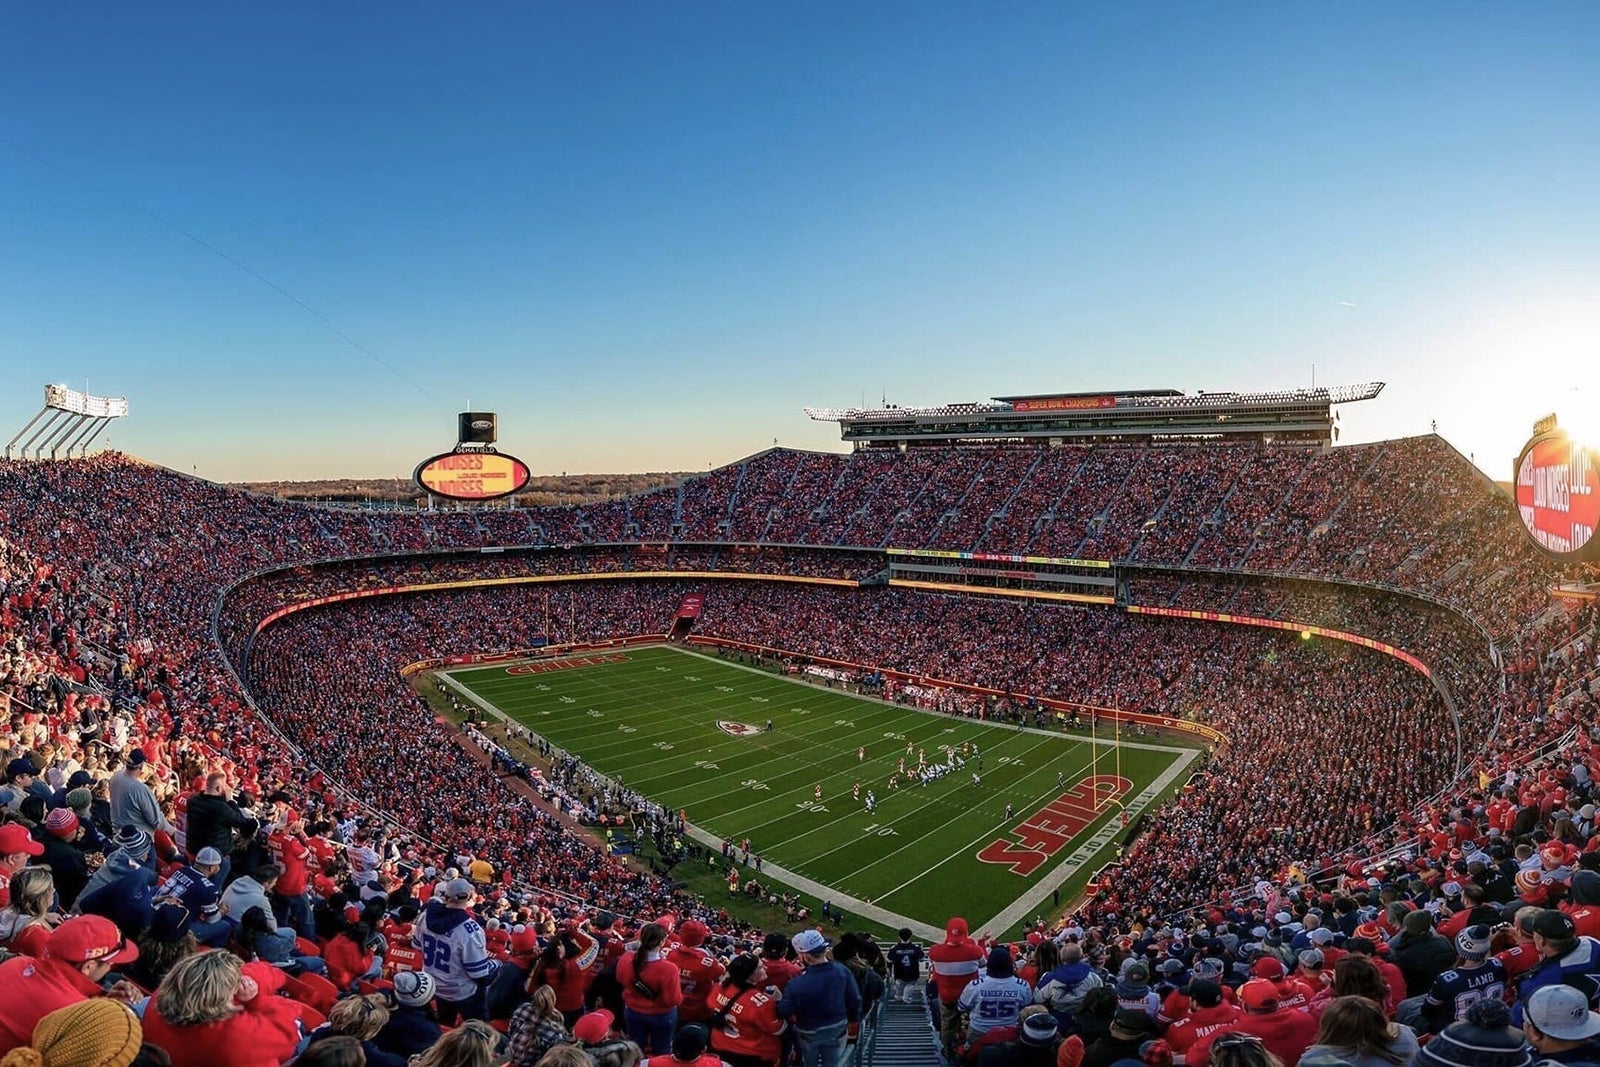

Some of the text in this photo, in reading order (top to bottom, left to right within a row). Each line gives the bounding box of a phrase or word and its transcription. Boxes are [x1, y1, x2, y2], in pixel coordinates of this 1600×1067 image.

[1029, 401, 1048, 409] SUPER
[1048, 400, 1064, 408] BOWL
[1066, 398, 1099, 408] CHAMPIONS
[1534, 464, 1570, 513] LOUD NOISES
[505, 652, 632, 675] CHIEFS
[796, 801, 825, 813] 20
[863, 823, 893, 836] 10
[976, 774, 1134, 877] CHIEFS
[1084, 842, 1102, 852] OF
[1066, 854, 1087, 866] US
[464, 921, 479, 933] 82
[422, 933, 451, 974] 82
[902, 955, 910, 966] 4
[1468, 972, 1494, 988] LAMB
[716, 993, 744, 1014] MAHOES
[980, 1000, 1017, 1018] 55
